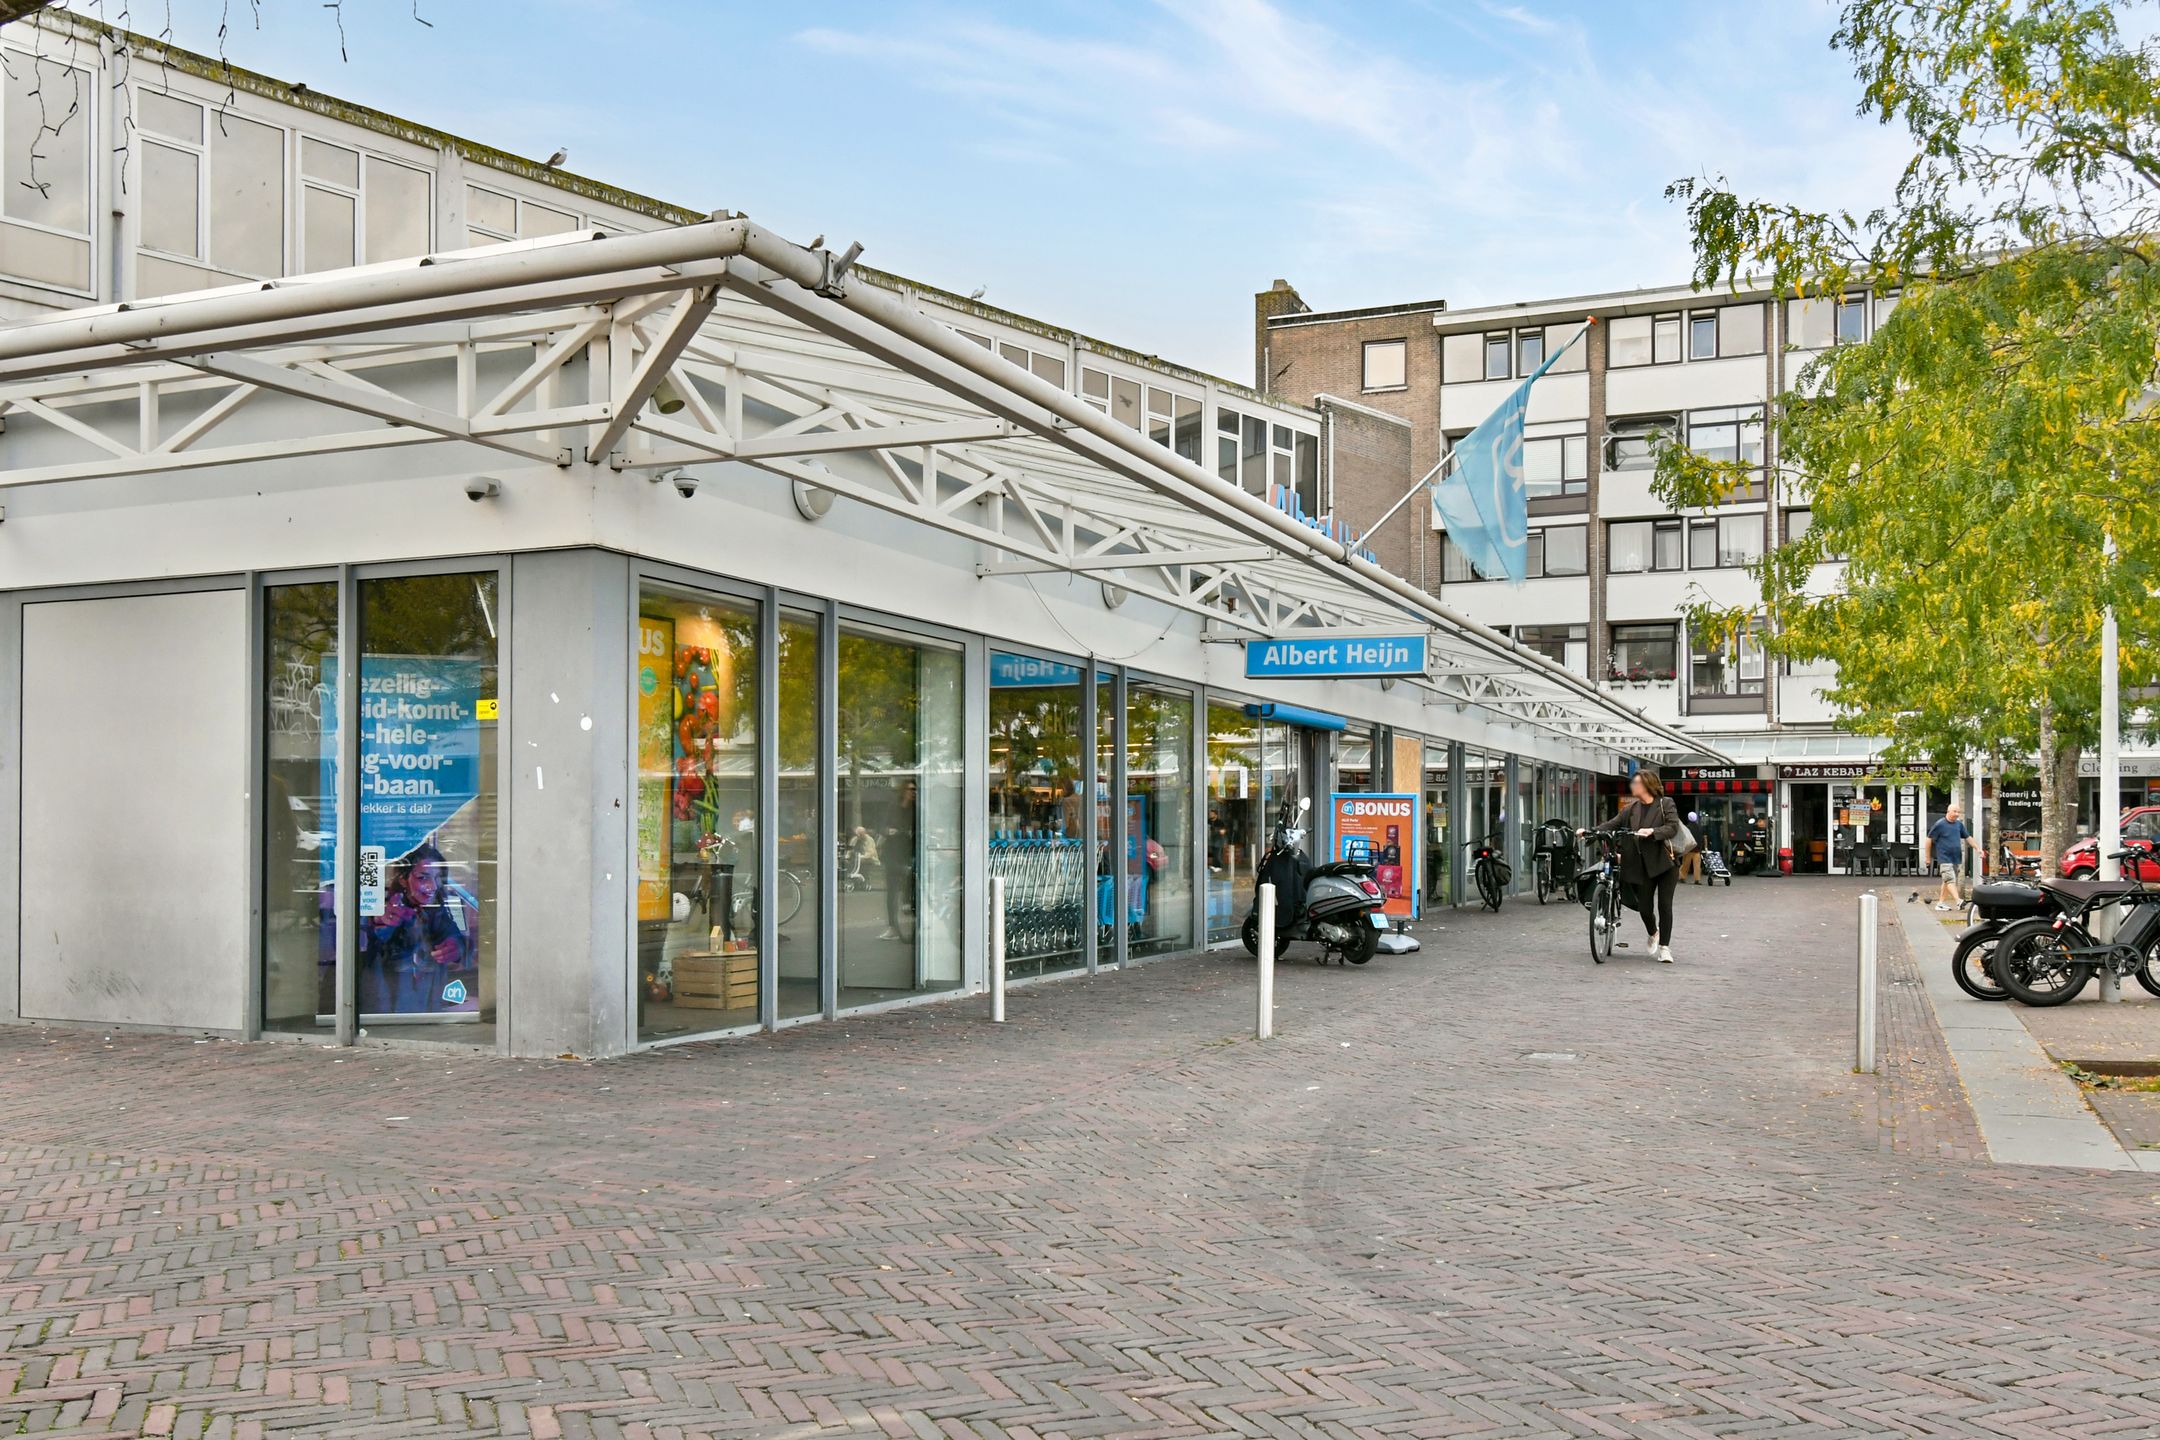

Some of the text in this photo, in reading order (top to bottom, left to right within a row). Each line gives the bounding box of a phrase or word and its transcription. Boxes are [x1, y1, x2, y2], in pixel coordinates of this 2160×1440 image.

[1263, 643, 1408, 668] Albert Heijn
[336, 673, 440, 698] ezellig-
[337, 698, 469, 720] id-komt-
[336, 723, 438, 745] -hele-
[336, 753, 453, 774] g-voor-
[1681, 769, 1688, 779] I
[1699, 768, 1736, 779] Sushi
[1795, 766, 1864, 777] LAZ KEBAB
[2031, 790, 2037, 798] &
[361, 803, 432, 813] lekker is dat?
[1355, 802, 1411, 816] BONUS
[2002, 831, 2025, 839] OPEN
